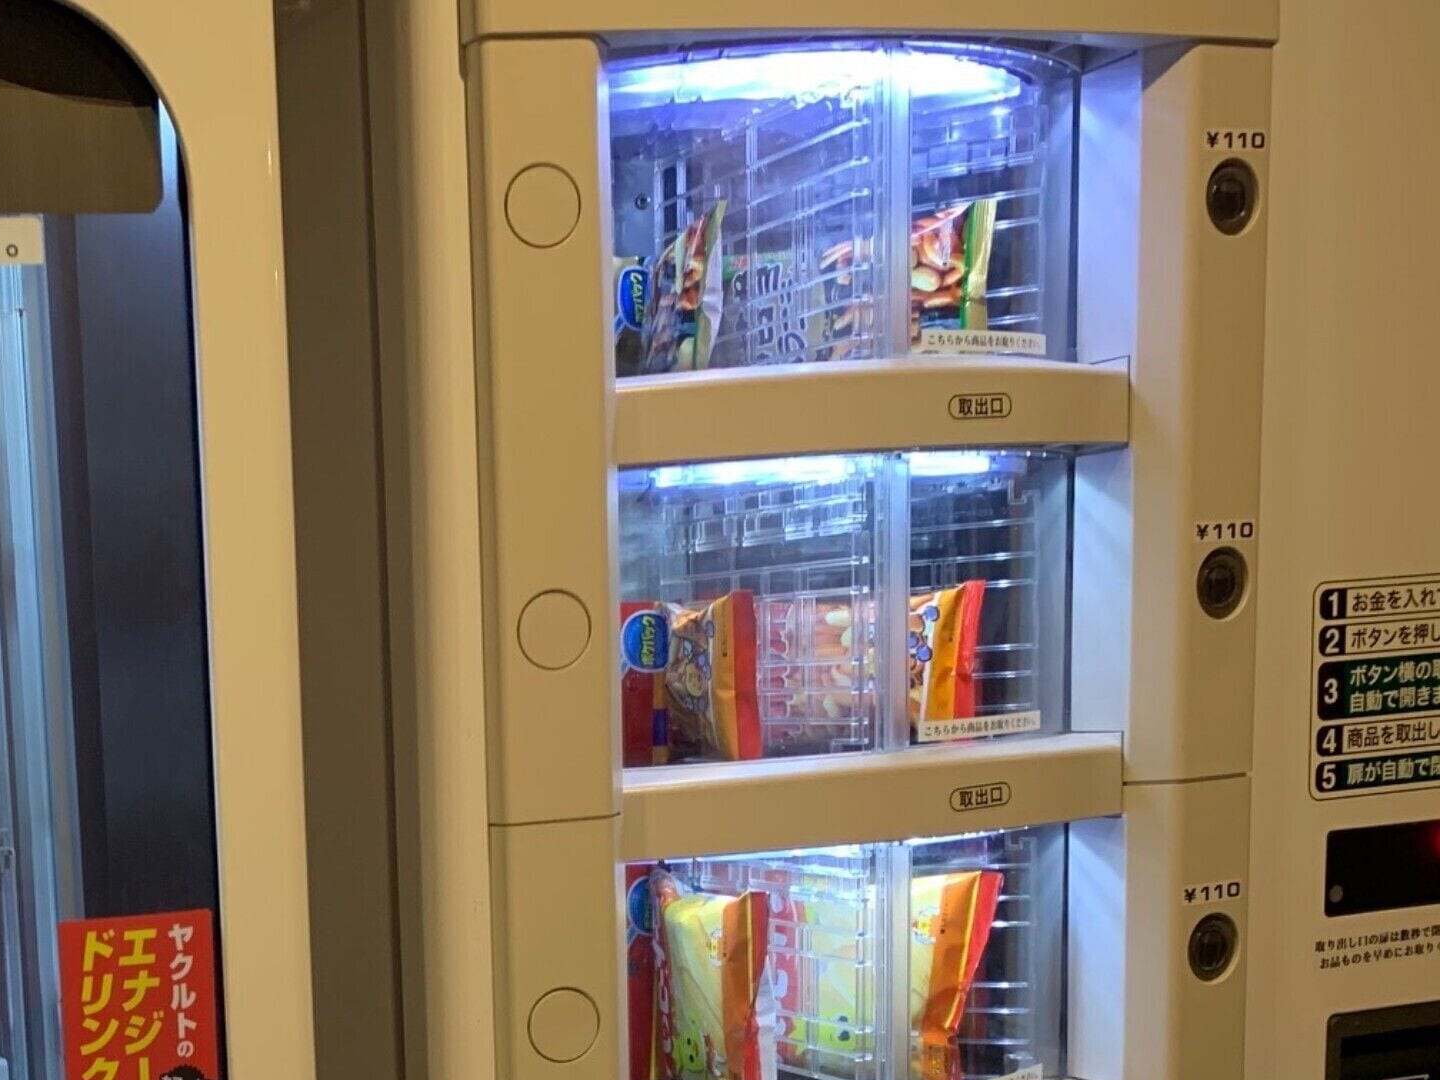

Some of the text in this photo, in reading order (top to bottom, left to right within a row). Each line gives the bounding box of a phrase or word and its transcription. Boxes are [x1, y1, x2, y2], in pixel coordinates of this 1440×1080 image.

[1206, 131, 1266, 150] ¥110
[958, 397, 1004, 415] 取出口
[1196, 522, 1254, 540] ¥110
[1327, 591, 1340, 617] 1
[1325, 628, 1340, 654] 2
[1324, 677, 1339, 704] 3
[1322, 728, 1337, 754] 4
[1321, 764, 1336, 790] 5
[959, 787, 1004, 807] 取出口
[1183, 881, 1241, 903] ¥110
[167, 922, 197, 1059] ヤクルトの
